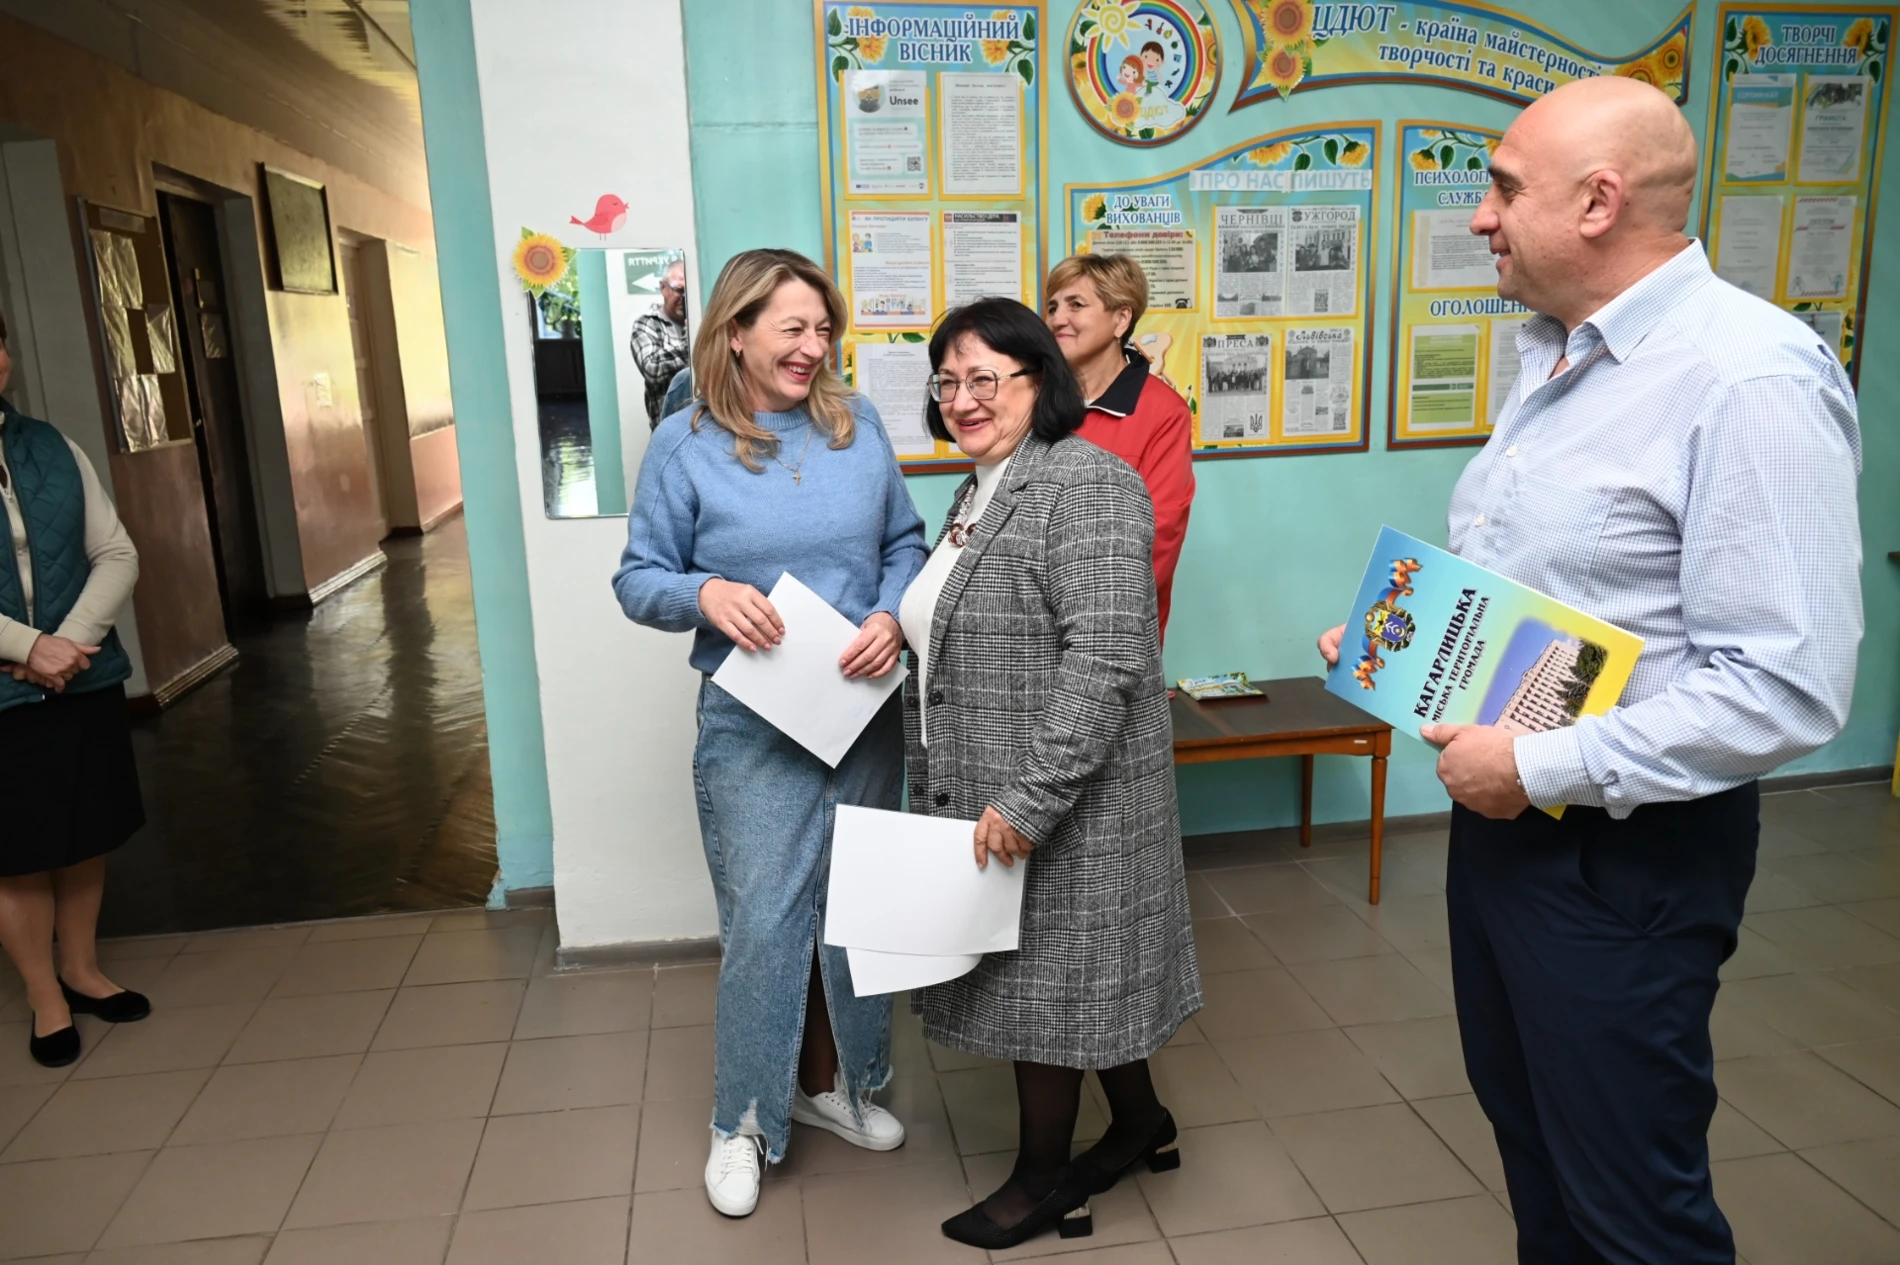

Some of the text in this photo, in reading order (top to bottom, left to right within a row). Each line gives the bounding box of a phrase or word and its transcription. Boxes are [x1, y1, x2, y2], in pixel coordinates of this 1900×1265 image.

[848, 13, 1020, 42] ІНФОРМАЦІЙНИЙ
[1312, 5, 1395, 38] ЦДЮТ
[1416, 17, 1477, 45] країна
[1782, 26, 1836, 43] ТВОРЧІ
[899, 41, 971, 62] ВІСНИК
[1755, 46, 1858, 65] ДОСЯГНЕННЯ
[1379, 44, 1555, 94] творчості та краси
[889, 95, 919, 106] Unsee
[1200, 172, 1371, 189] ПРО НАС ПИШУТЬ
[1415, 170, 1490, 185] ПСИХОЛОГІ
[1114, 195, 1170, 209] ДО УВАГИ
[1438, 190, 1487, 205] СЛУЖБ
[1106, 212, 1181, 225] ВИХОВАНЦІВ
[1221, 214, 1283, 226] ЧЕРНІВЦІ
[1304, 211, 1356, 221] УЖГОРОД
[1103, 231, 1150, 239] Телефони
[1217, 339, 1254, 348] ПРЕСА
[1413, 588, 1477, 718] КАГАРЛИЦЬКА
[1432, 597, 1489, 723] МІСЬКА ТЕРИТОРІАЛЬНА
[1459, 640, 1485, 690] ГРОМАДА
